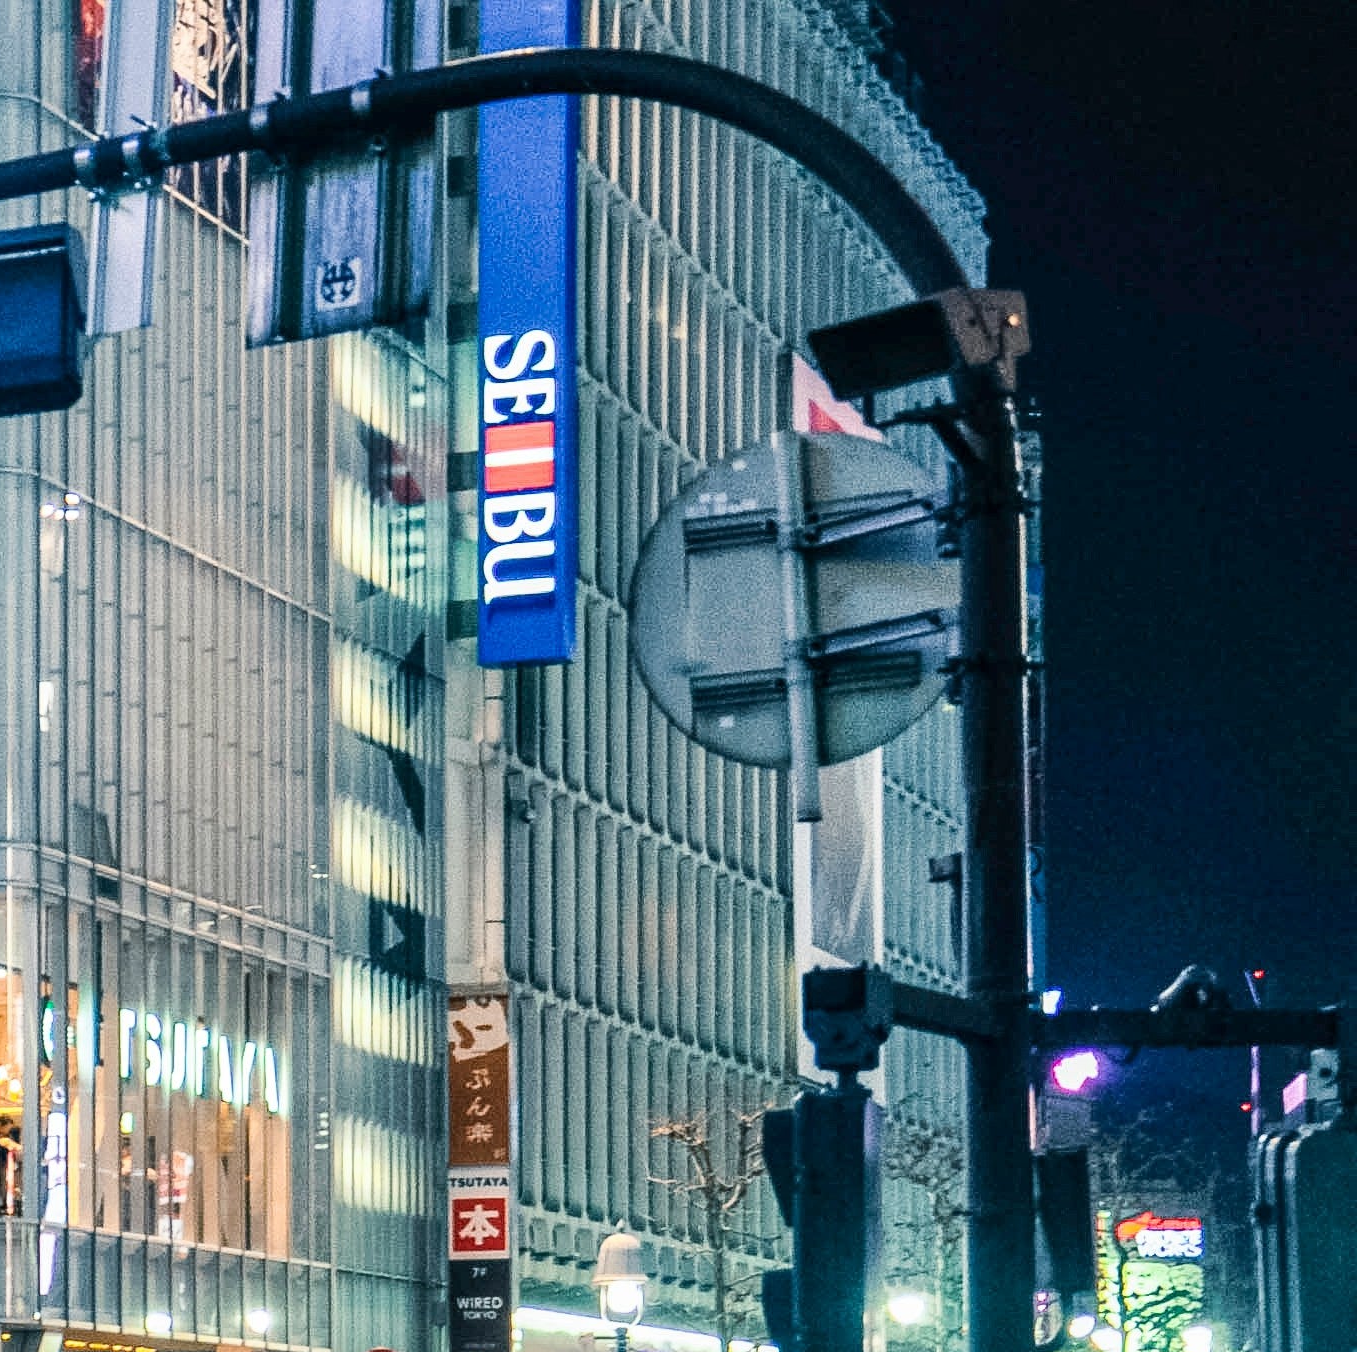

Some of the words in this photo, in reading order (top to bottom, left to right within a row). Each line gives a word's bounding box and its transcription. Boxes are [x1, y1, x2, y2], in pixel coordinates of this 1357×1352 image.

[483, 328, 556, 605] SEIBU
[449, 1176, 510, 1188] TSUTAYA
[458, 1203, 500, 1247] 本
[455, 1296, 504, 1310] WIRED
